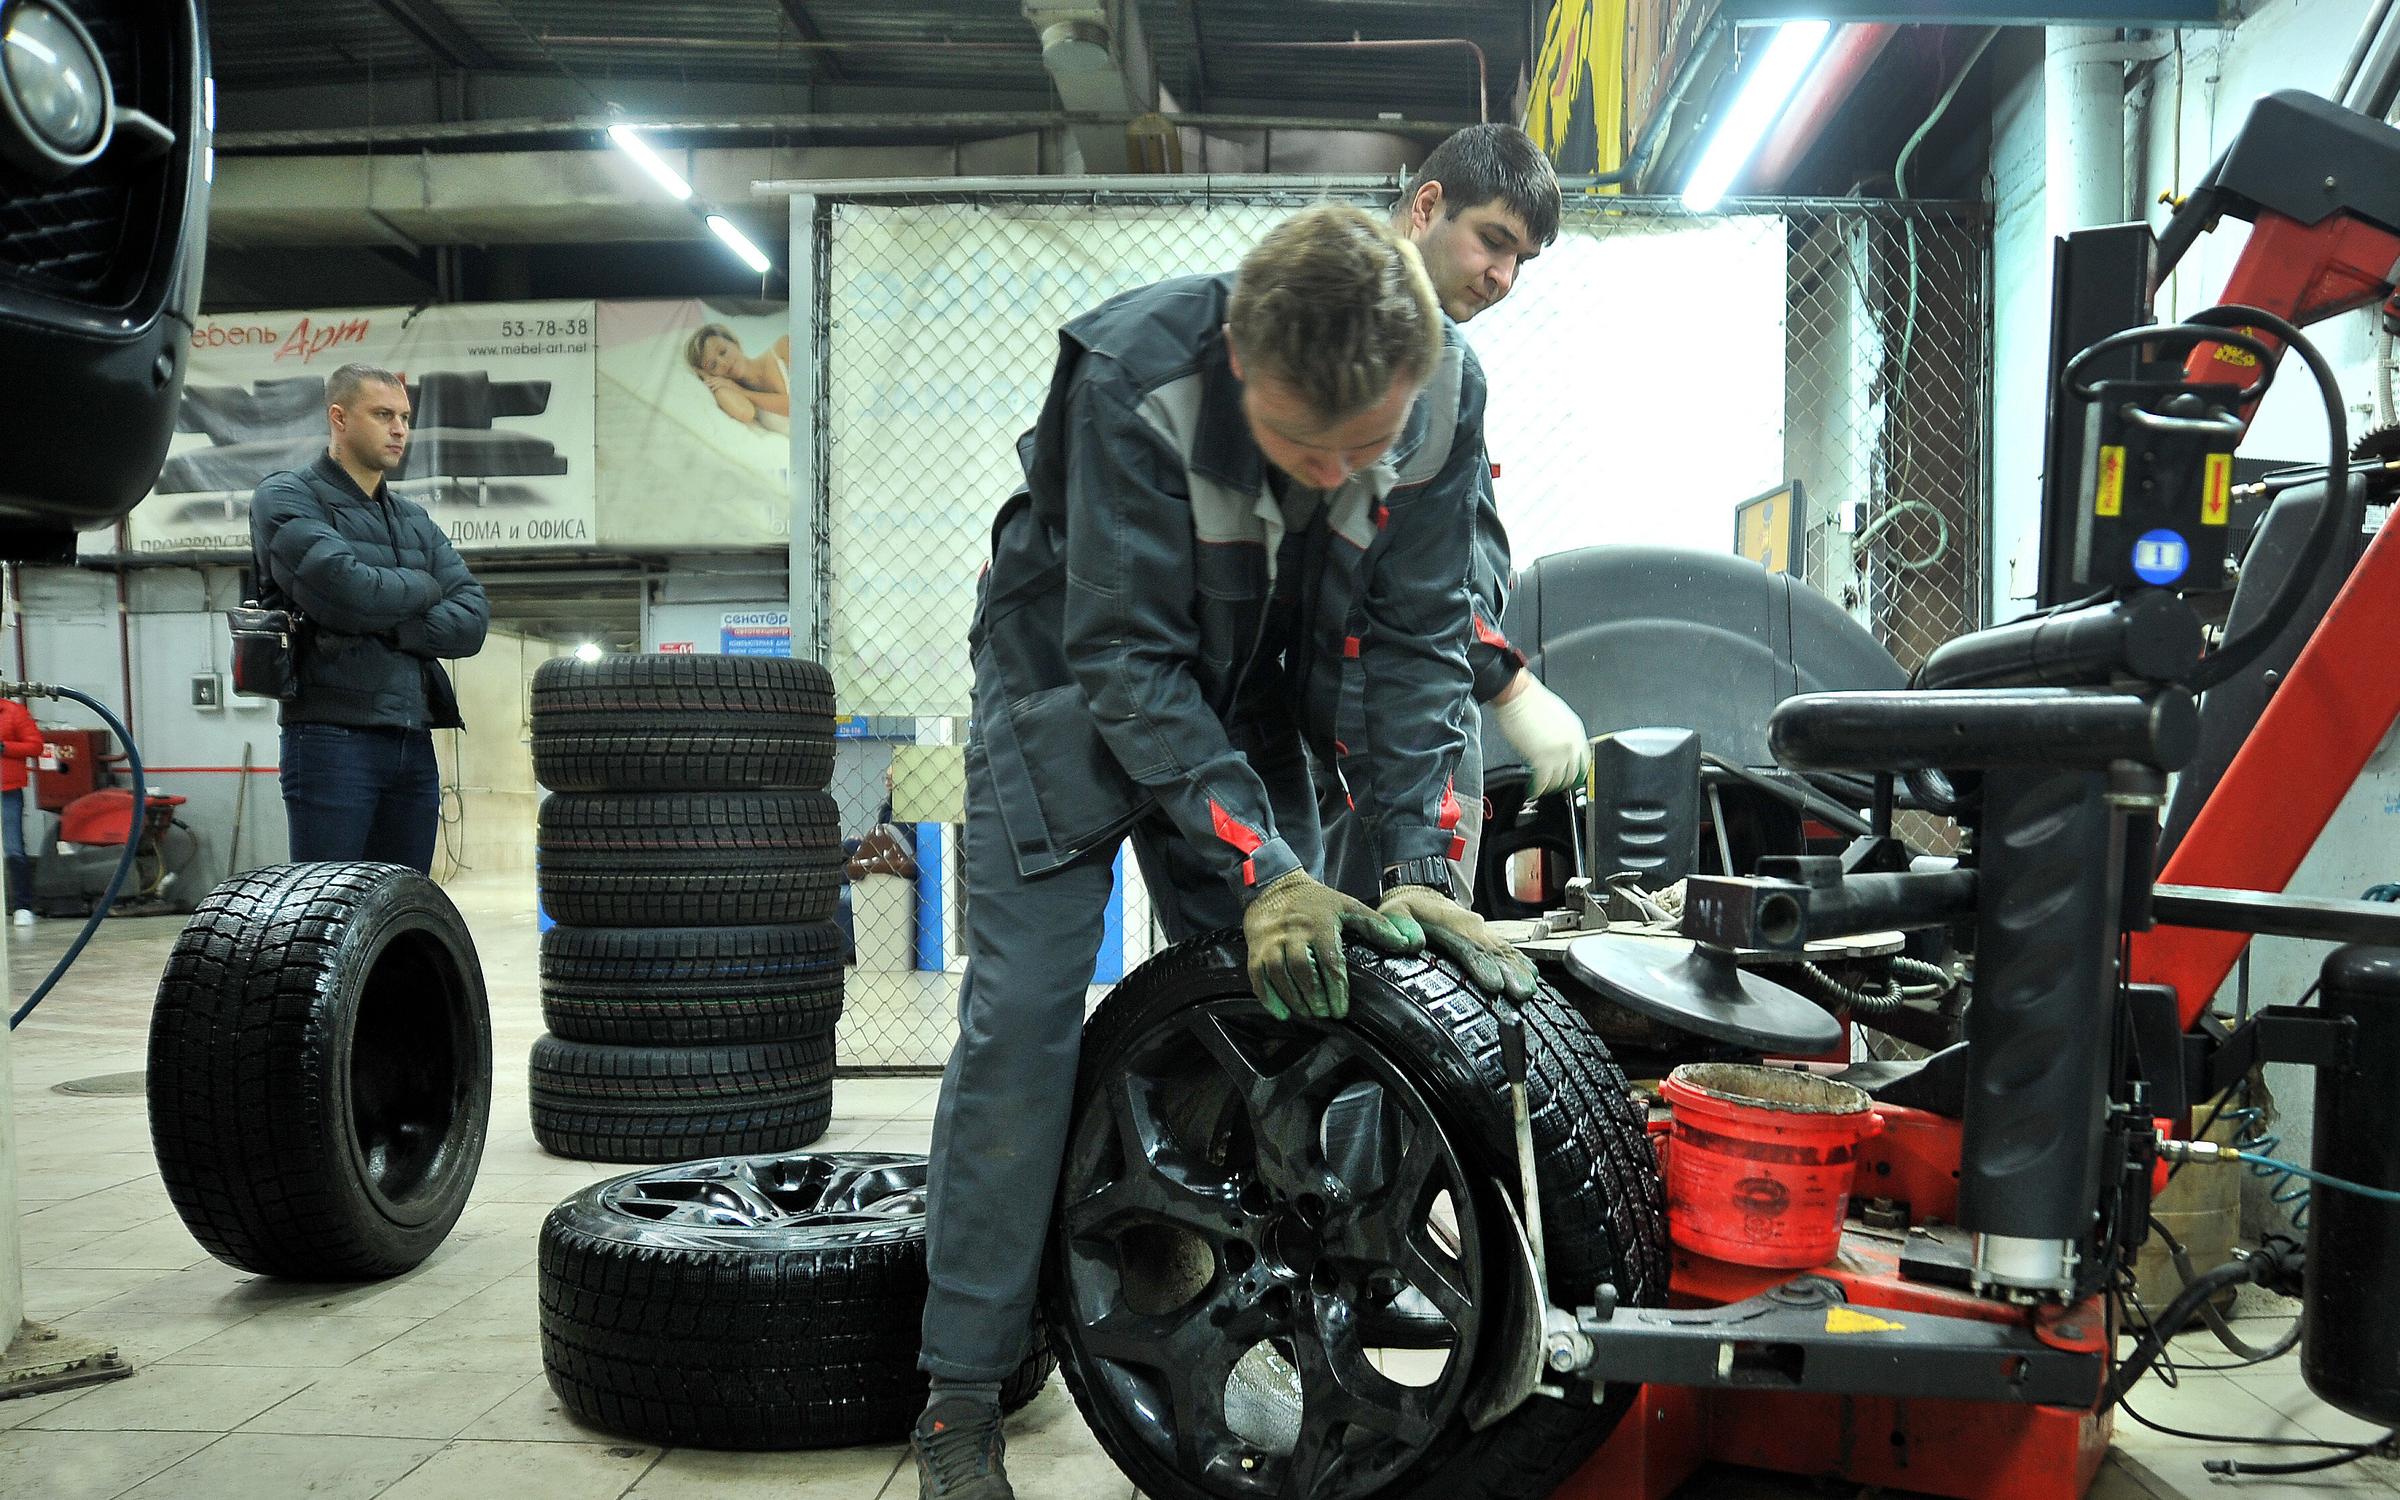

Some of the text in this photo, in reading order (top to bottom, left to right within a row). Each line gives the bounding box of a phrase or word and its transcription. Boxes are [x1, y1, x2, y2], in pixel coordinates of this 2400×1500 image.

[501, 319, 588, 337] 53-78-38
[190, 317, 370, 365] ебель Арт
[467, 341, 587, 357] www.mebel-art.net
[450, 517, 587, 544] ДОМА и ОФИСА
[140, 534, 250, 552] ПРОИЗВОДСТВ
